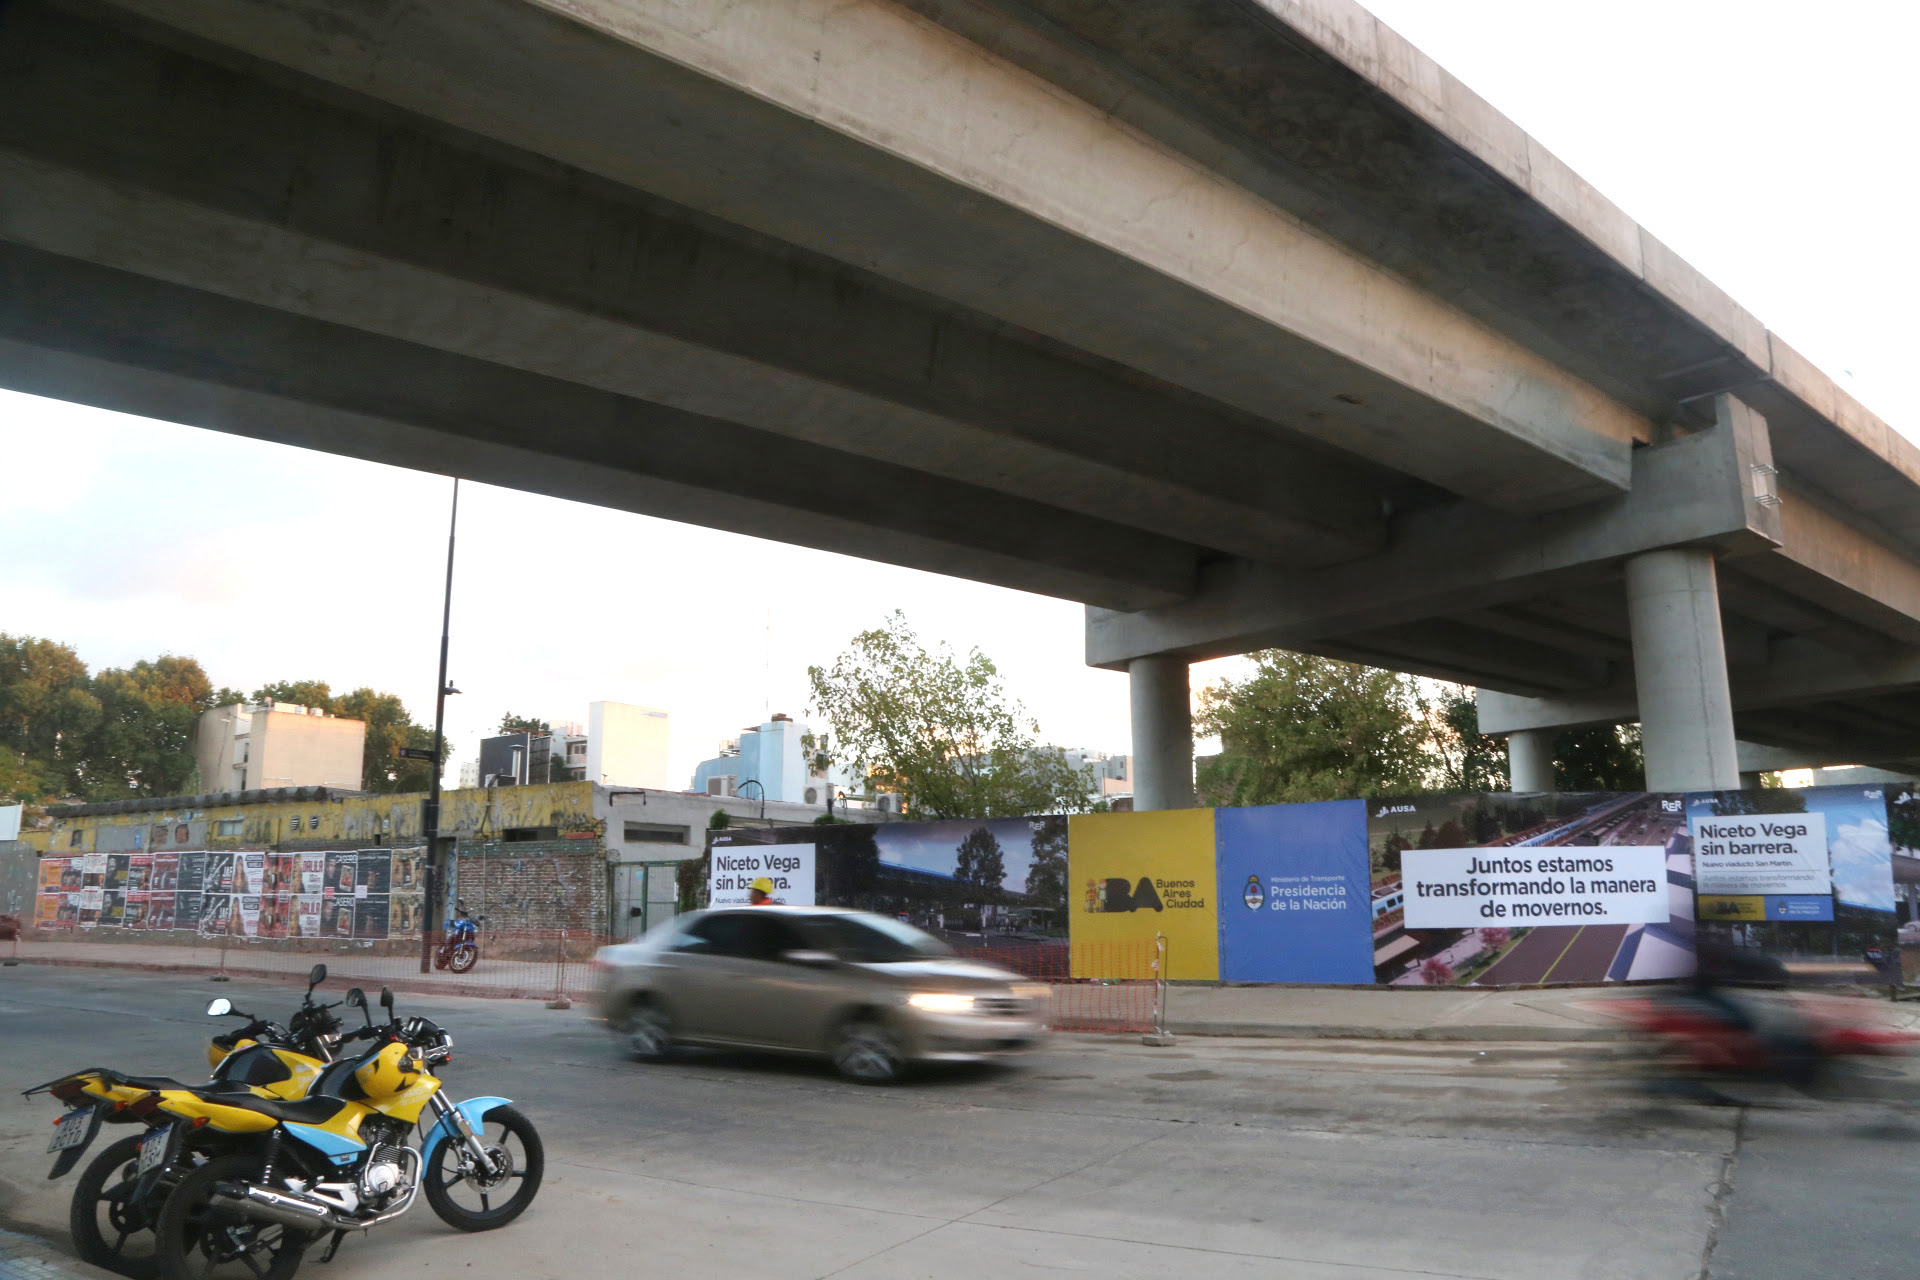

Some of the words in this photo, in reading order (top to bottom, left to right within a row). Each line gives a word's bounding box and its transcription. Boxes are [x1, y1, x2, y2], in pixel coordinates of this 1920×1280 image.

[1390, 804, 1416, 813] AUSA
[1661, 800, 1682, 812] RER
[1029, 821, 1046, 831] RER
[1700, 824, 1756, 839] Niceto
[1760, 823, 1807, 839] Vega
[1701, 841, 1725, 855] sin
[1729, 841, 1797, 855] barrera.
[716, 856, 760, 871] Niceto
[764, 855, 800, 872] Vega
[1466, 857, 1533, 875] Juntos
[1537, 857, 1613, 873] estamos
[716, 875, 734, 890] sin
[1156, 879, 1195, 888] Buenos
[1416, 877, 1566, 897] transformando
[1570, 877, 1586, 894] la
[1591, 878, 1657, 894] manera
[1102, 877, 1164, 912] BA
[1163, 889, 1191, 898] Aires
[1271, 884, 1346, 897] Presidencia
[1166, 898, 1205, 909] Ciudad
[1271, 899, 1287, 911] de
[1290, 899, 1300, 910] la
[1303, 898, 1346, 910] Nación
[1480, 900, 1506, 918] de
[1512, 900, 1608, 917] movernos.
